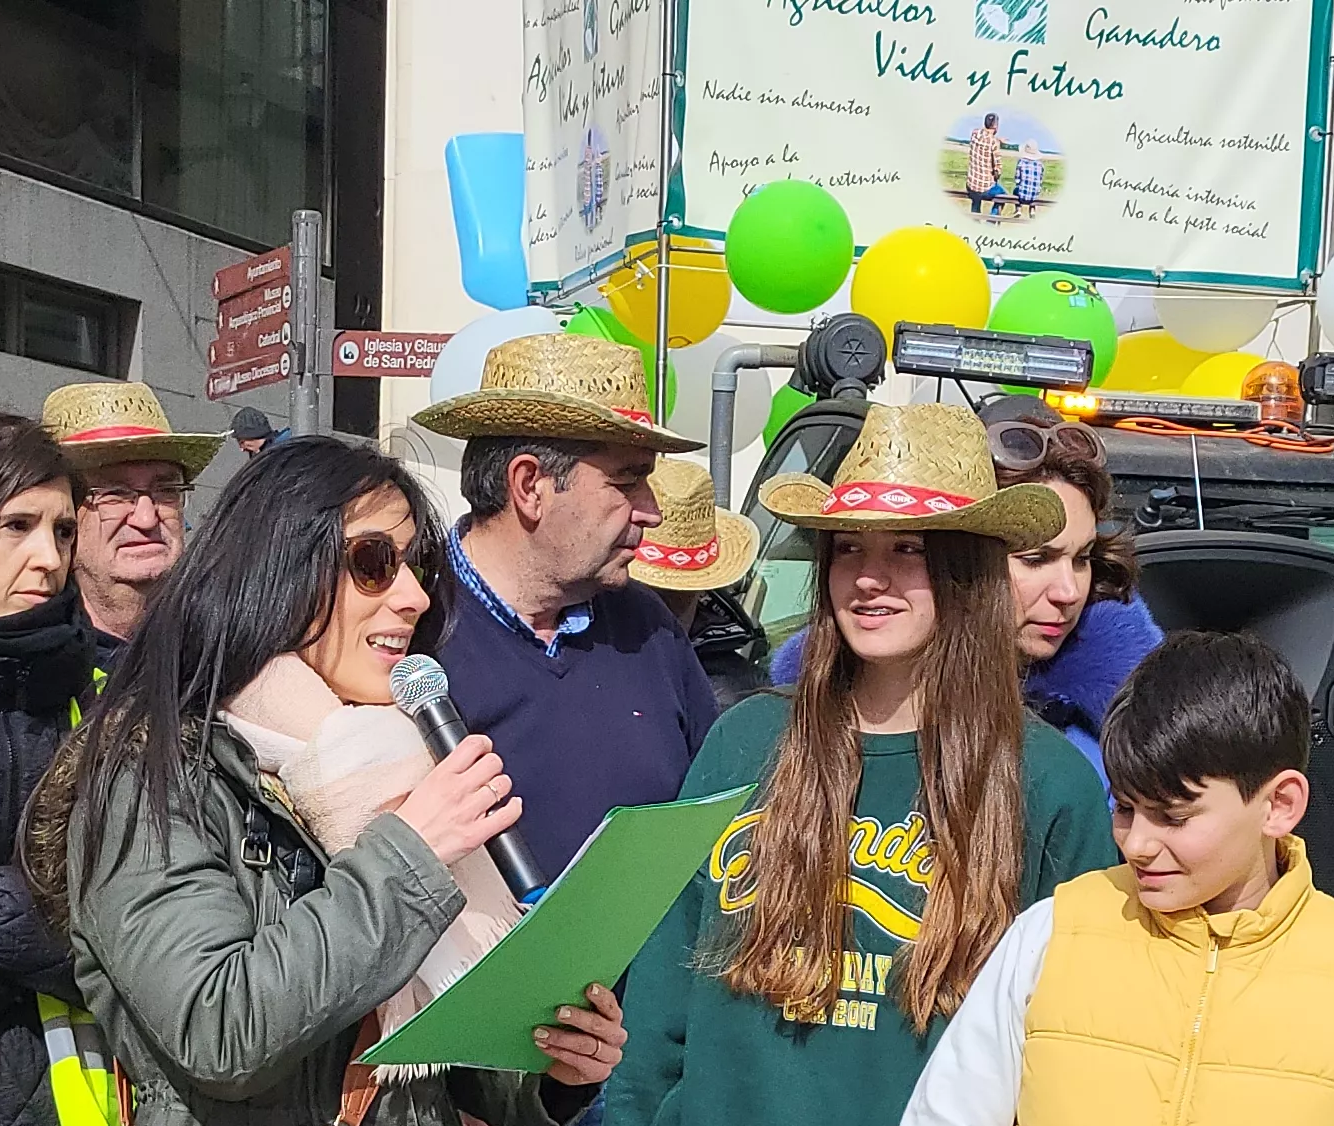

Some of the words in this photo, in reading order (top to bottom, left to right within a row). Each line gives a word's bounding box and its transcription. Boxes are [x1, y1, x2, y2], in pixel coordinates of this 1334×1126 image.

[767, 0, 937, 26] gricultor
[1085, 7, 1221, 51] Ganadero
[875, 31, 953, 84] Vida
[967, 70, 991, 105] y
[1007, 49, 1124, 100] Futuro
[702, 80, 752, 102] Nadie
[757, 89, 786, 105] sin
[791, 90, 871, 116] alimentos
[1125, 122, 1213, 150] Agricultura
[1219, 132, 1291, 153] sostenible
[709, 150, 759, 176] Apoyo
[765, 154, 776, 165] a
[782, 144, 800, 163] la
[829, 168, 901, 188] extensiva
[1102, 168, 1180, 199] Ganadería
[1184, 186, 1257, 211] intensiva
[1122, 200, 1144, 219] No
[1148, 212, 1158, 222] a
[1163, 207, 1179, 225] la
[1183, 216, 1218, 234] peste
[1222, 222, 1269, 240] social
[975, 235, 1075, 255] generacional
[363, 355, 380, 367] de
[381, 355, 404, 368] San
[364, 338, 403, 354] Iglesia
[404, 342, 413, 355] y
